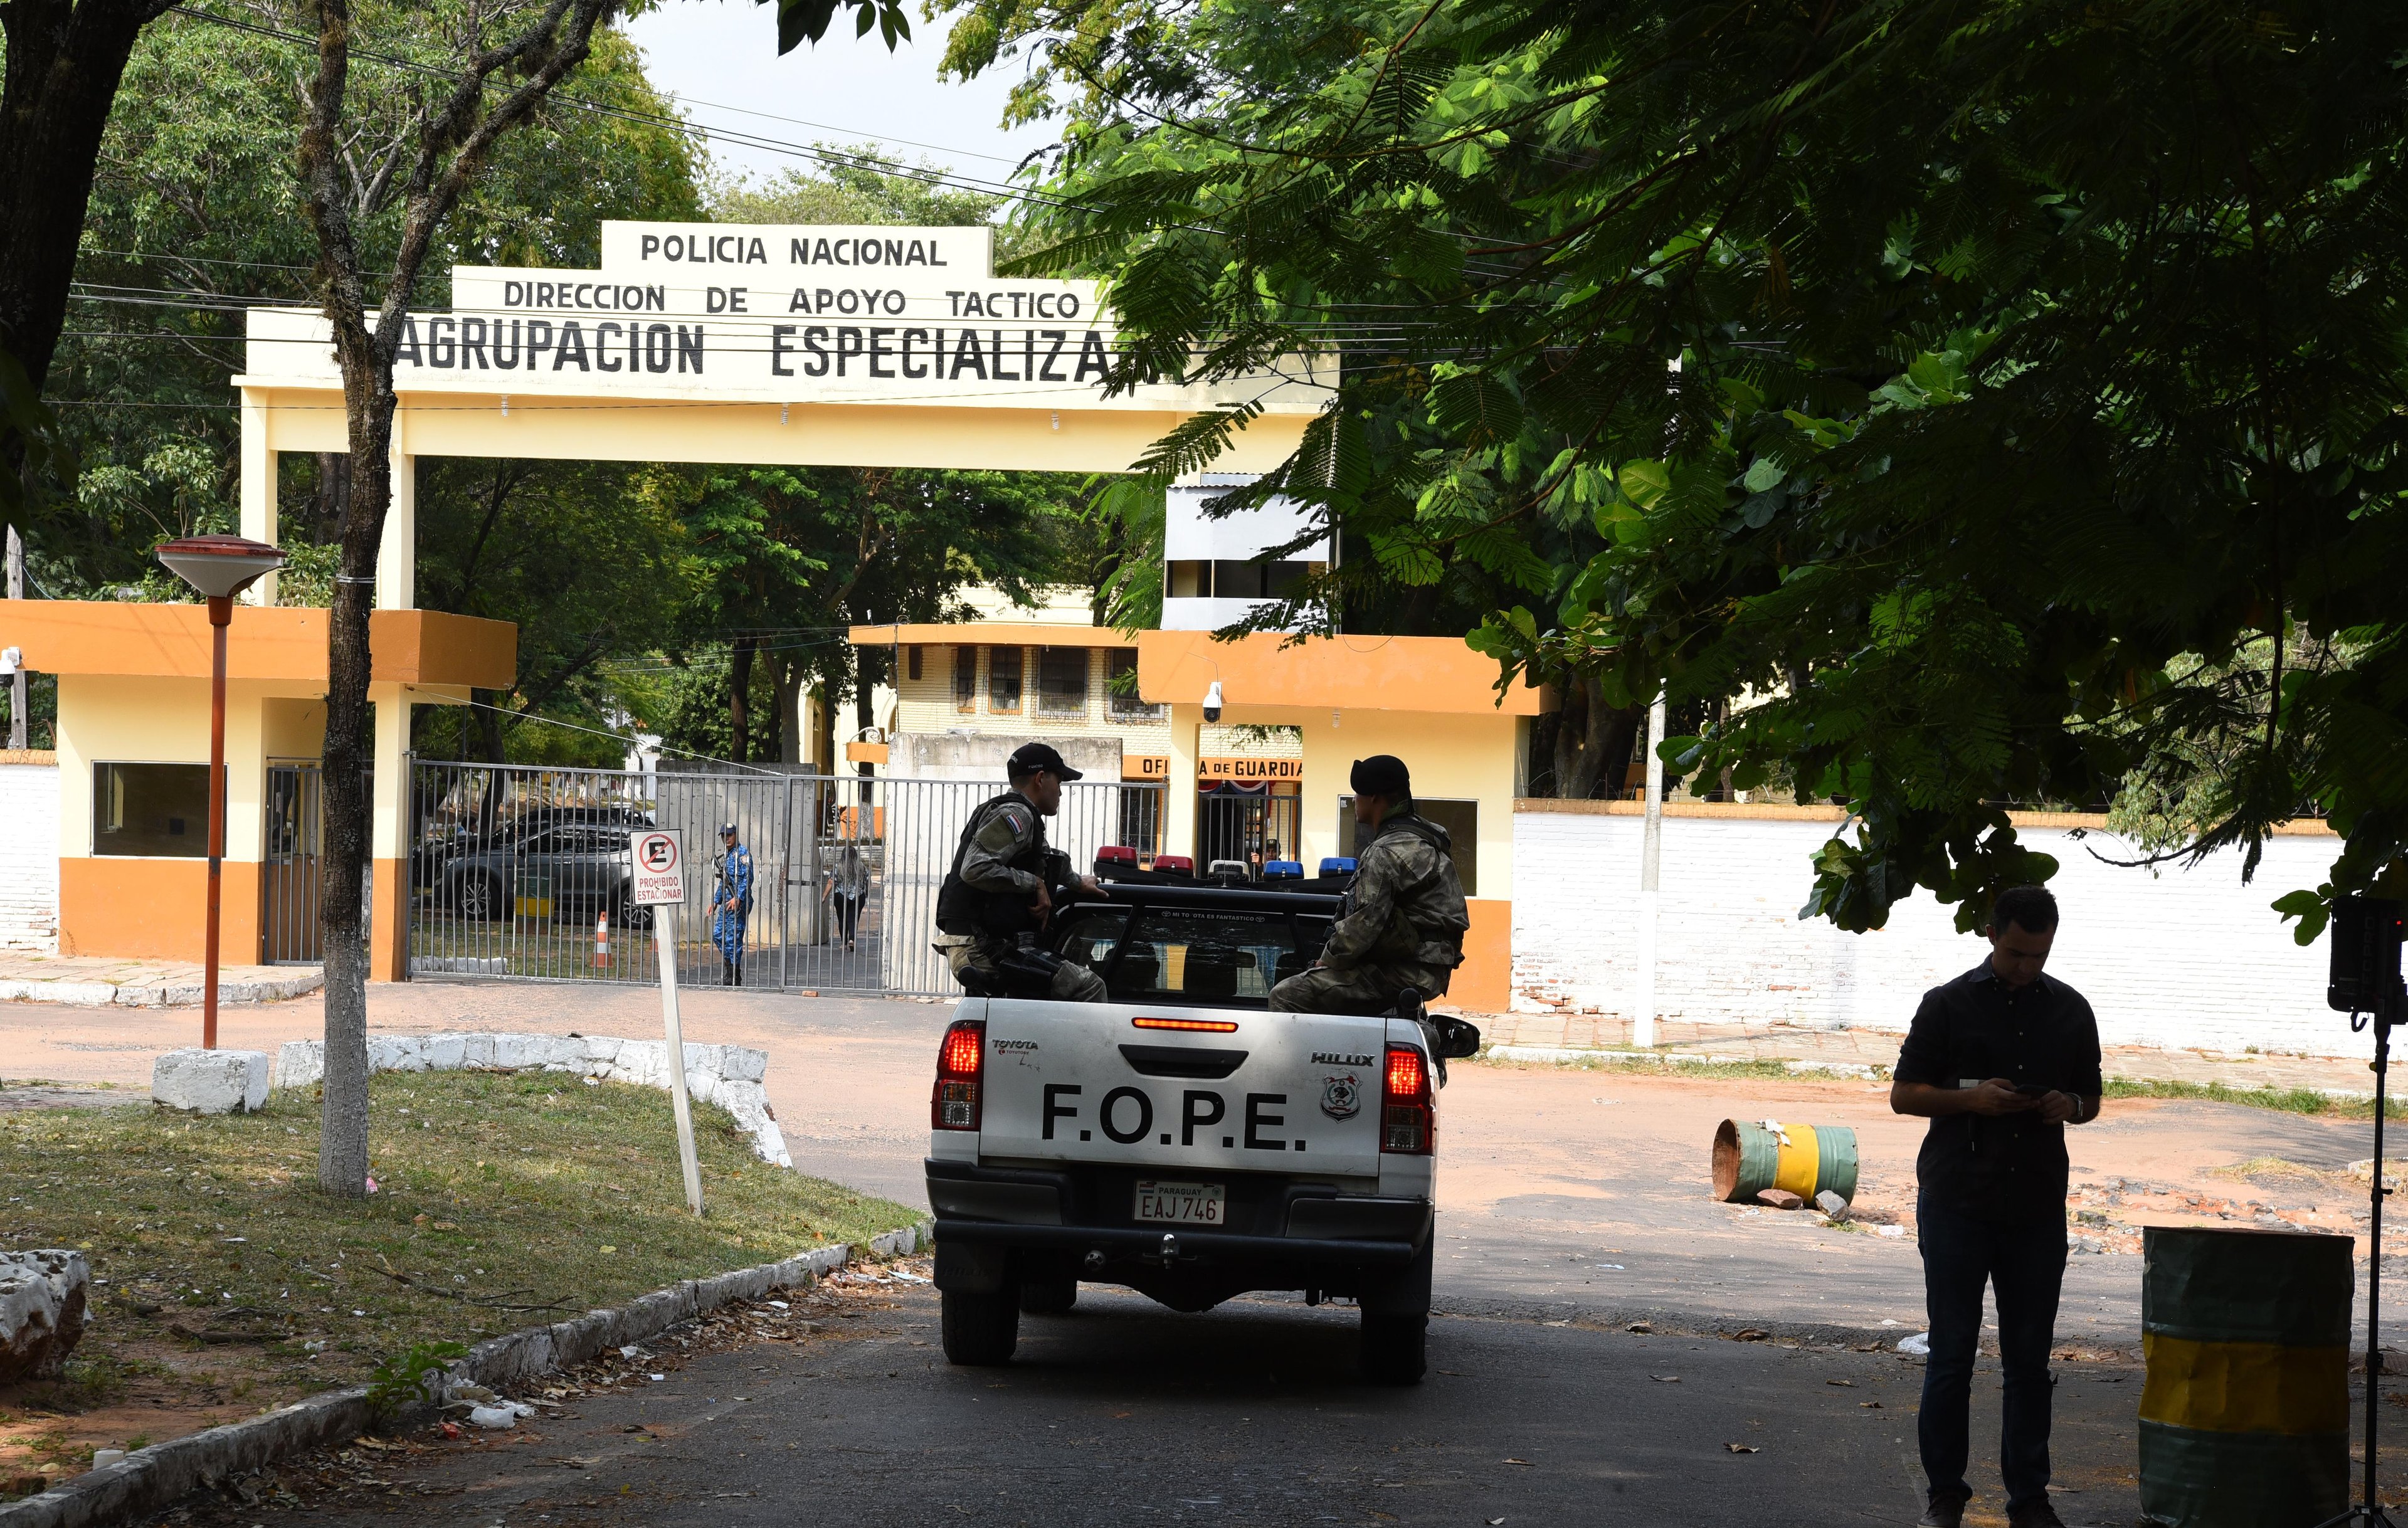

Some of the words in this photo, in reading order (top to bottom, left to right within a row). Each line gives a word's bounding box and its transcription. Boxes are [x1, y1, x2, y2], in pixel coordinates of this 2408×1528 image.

[642, 234, 767, 265] POLICIA
[791, 238, 948, 267] NACIONAL
[505, 281, 665, 311] DIRECCION
[706, 287, 748, 314] DE
[788, 288, 906, 315] APOYO
[945, 290, 1080, 319] TACTICO
[391, 315, 704, 374] AGRUPACION
[771, 324, 1185, 385] ESPECIALIZA
[1143, 759, 1208, 775] OFIA
[1213, 763, 1230, 773] DE
[1235, 761, 1302, 776] GUARDIA
[648, 841, 667, 863] E
[639, 876, 679, 888] PROHIBIDO
[637, 888, 682, 901] ESTACIONAR
[992, 1038, 1038, 1050] TOYOTA
[1310, 1051, 1375, 1067] HILUX
[1042, 1083, 1307, 1152] F.O.P.E.
[1158, 1187, 1202, 1196] PARAGUAY
[1141, 1195, 1176, 1219] EAJ
[1182, 1197, 1217, 1221] 746
